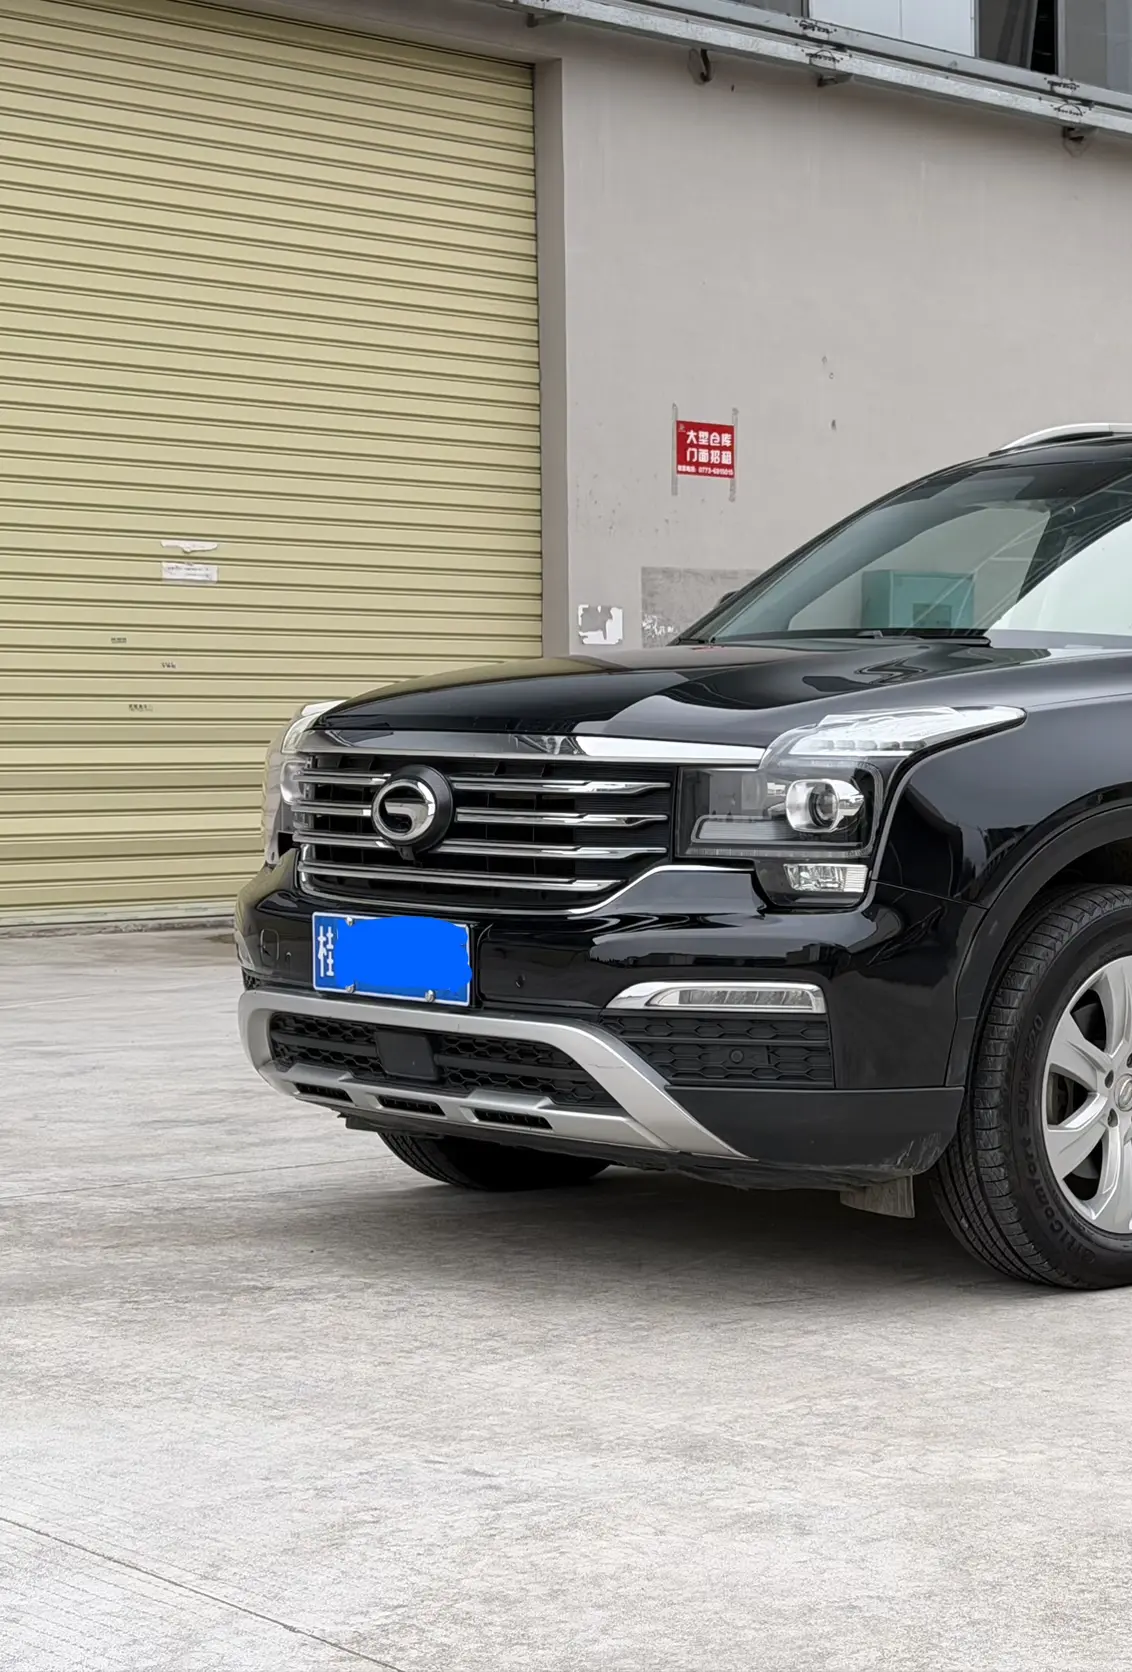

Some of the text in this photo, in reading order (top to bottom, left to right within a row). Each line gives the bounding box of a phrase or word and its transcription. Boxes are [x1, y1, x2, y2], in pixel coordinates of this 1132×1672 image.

[686, 429, 732, 447] 大型仓库
[686, 447, 732, 465] 门面招租
